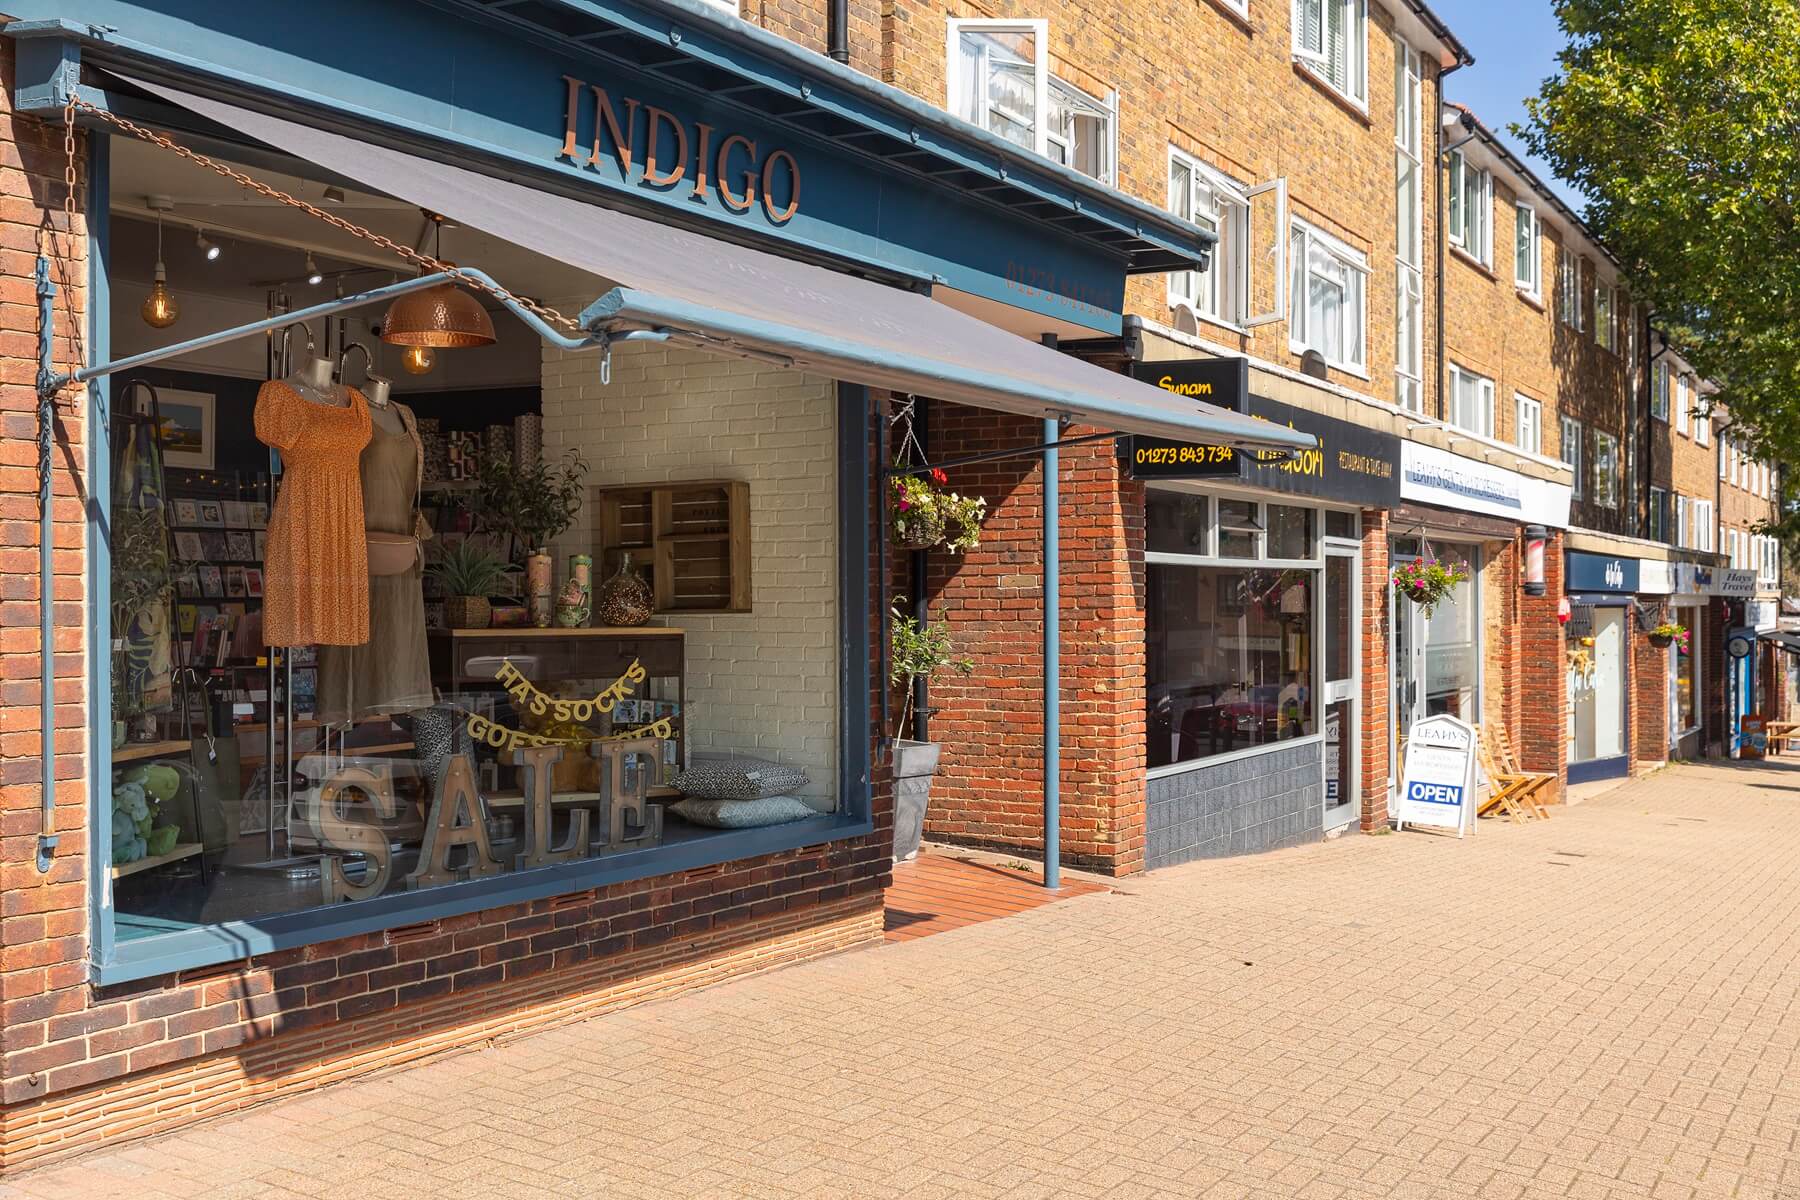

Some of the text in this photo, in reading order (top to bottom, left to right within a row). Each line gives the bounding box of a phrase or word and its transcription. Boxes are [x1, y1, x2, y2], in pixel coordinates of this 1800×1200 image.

[562, 74, 801, 223] INDIGO
[1136, 446, 1232, 464] 01273 843 734
[1722, 582, 1755, 591] Travel
[1726, 573, 1753, 583] Hays
[494, 659, 647, 722] HASSOCKS
[1411, 784, 1459, 804] OPEN
[309, 737, 664, 904] SALE
